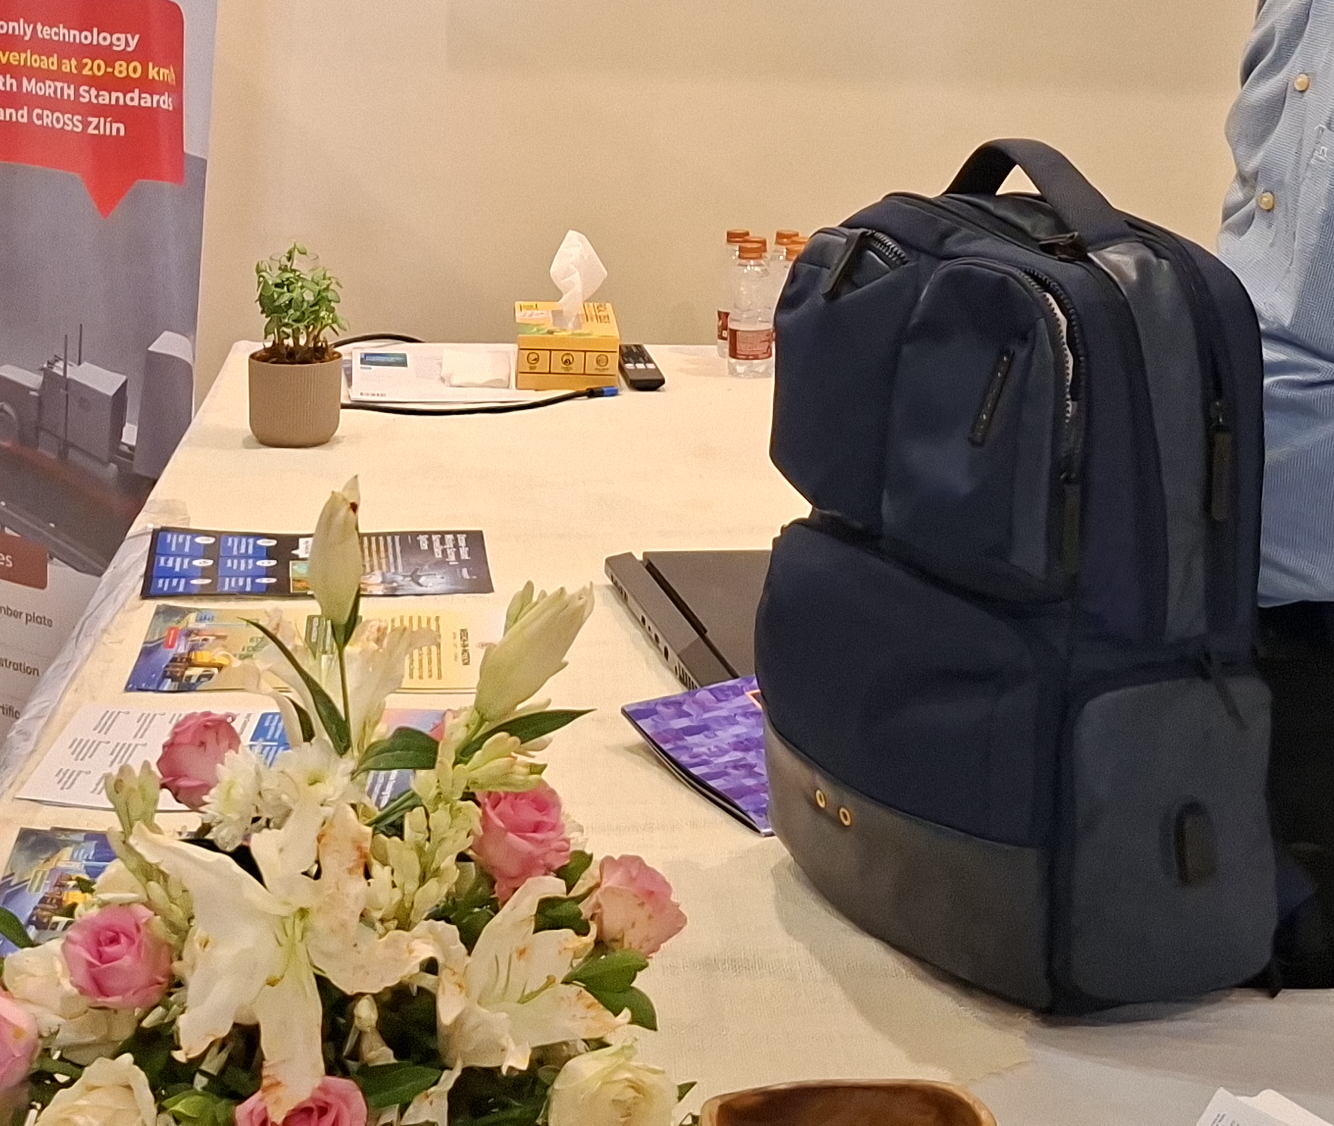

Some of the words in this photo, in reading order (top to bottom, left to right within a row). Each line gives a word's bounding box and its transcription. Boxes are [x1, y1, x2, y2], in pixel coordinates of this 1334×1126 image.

[37, 21, 140, 51] technology
[61, 58, 78, 74] at
[82, 58, 142, 79] 20-80
[22, 77, 74, 100] MoRTH
[79, 86, 174, 111] Standards
[33, 108, 82, 132] CROSS
